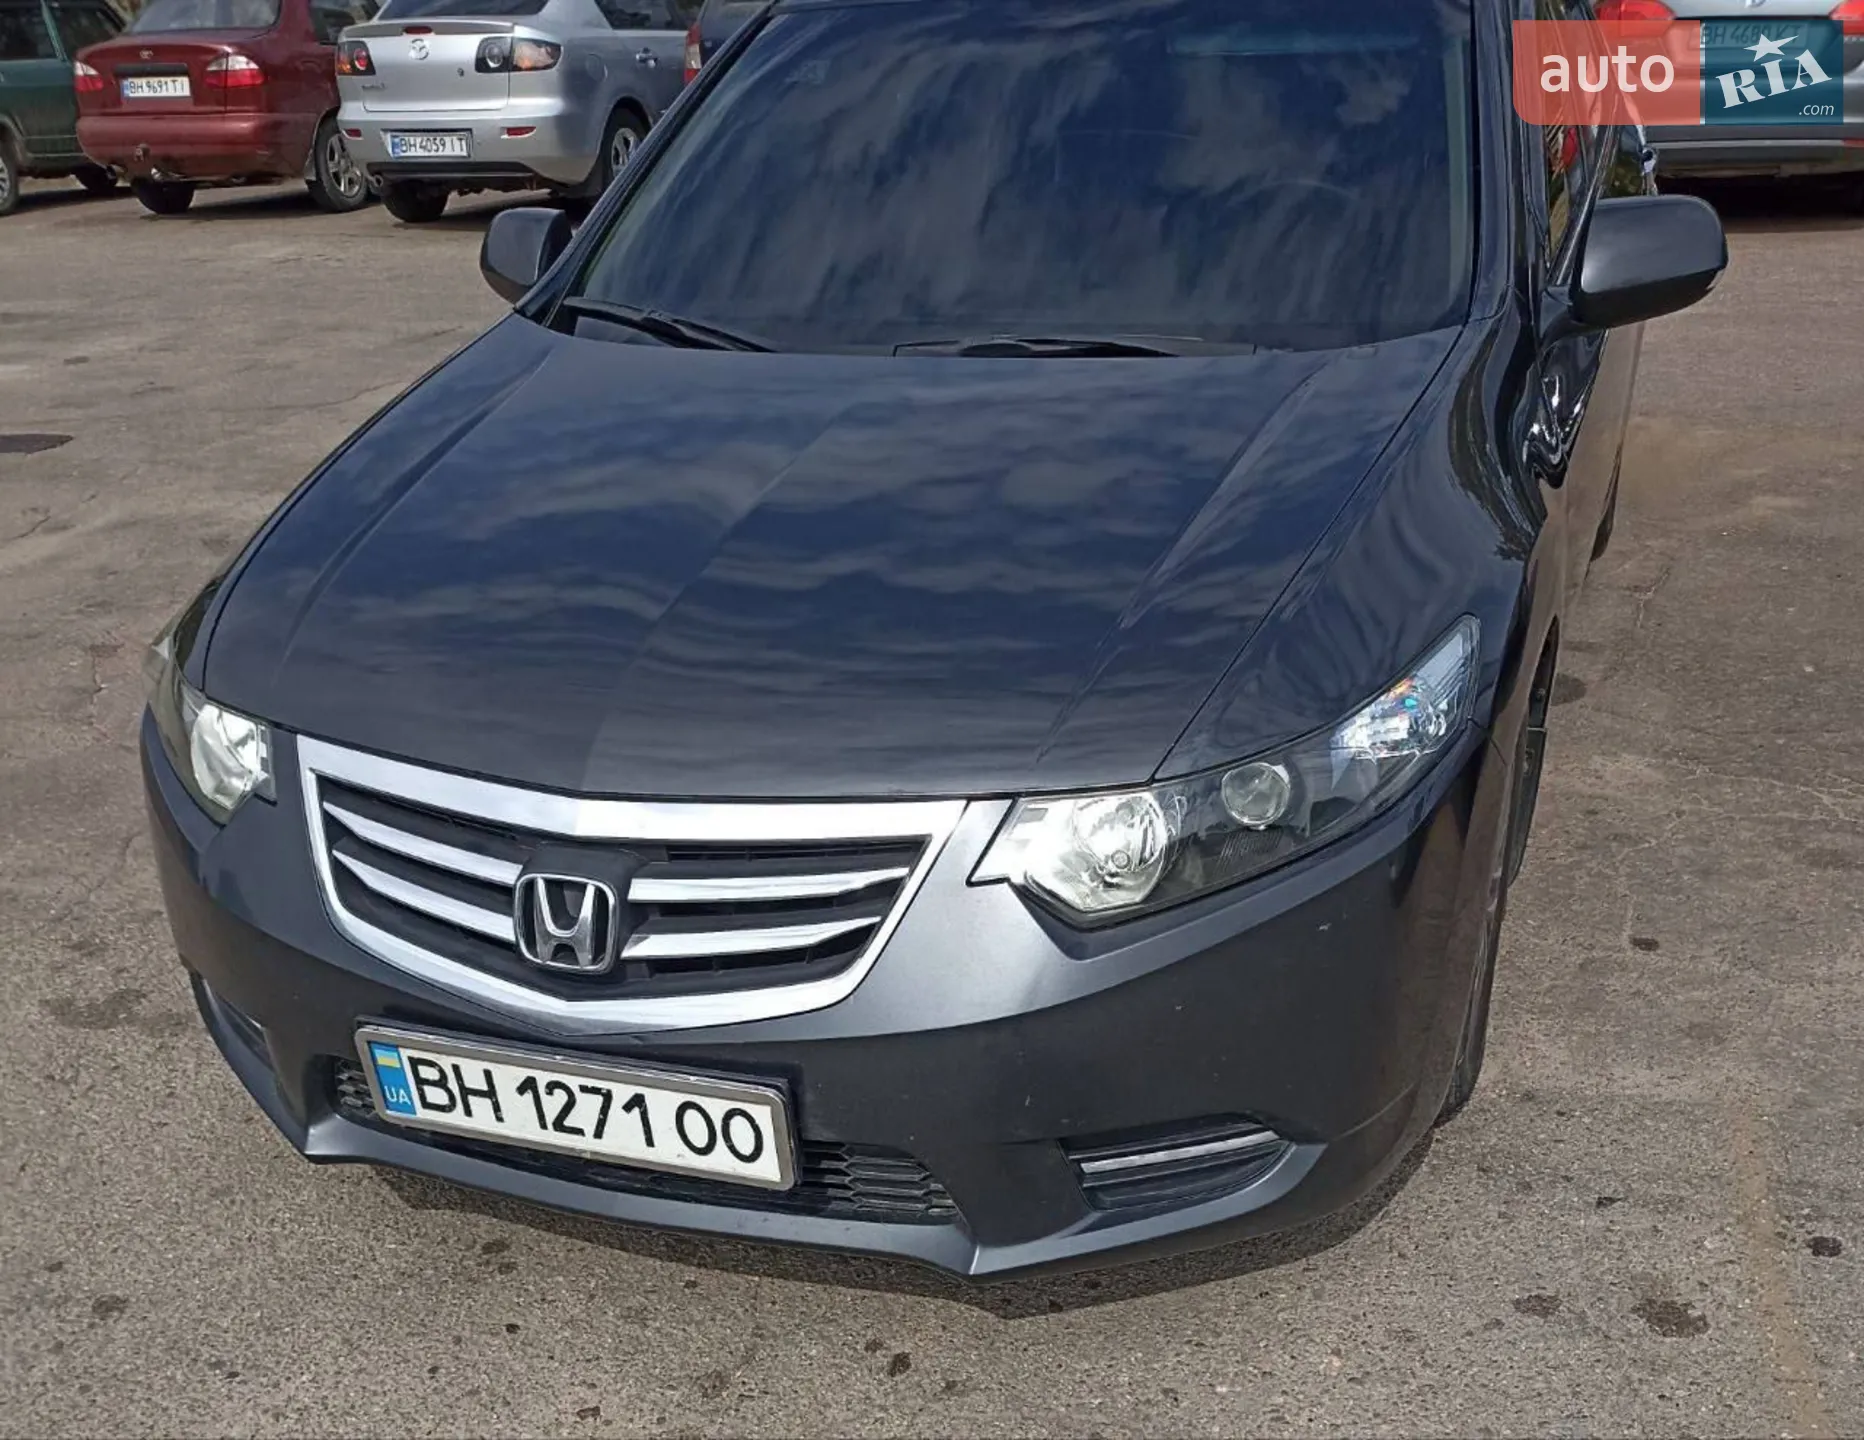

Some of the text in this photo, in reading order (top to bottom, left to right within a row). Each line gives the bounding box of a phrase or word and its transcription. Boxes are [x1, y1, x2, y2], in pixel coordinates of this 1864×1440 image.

[129, 80, 144, 94] BH
[399, 137, 417, 153] BH
[419, 137, 446, 153] 4059
[384, 1085, 412, 1105] UA
[408, 1056, 504, 1123] BH
[516, 1075, 656, 1148] 1271
